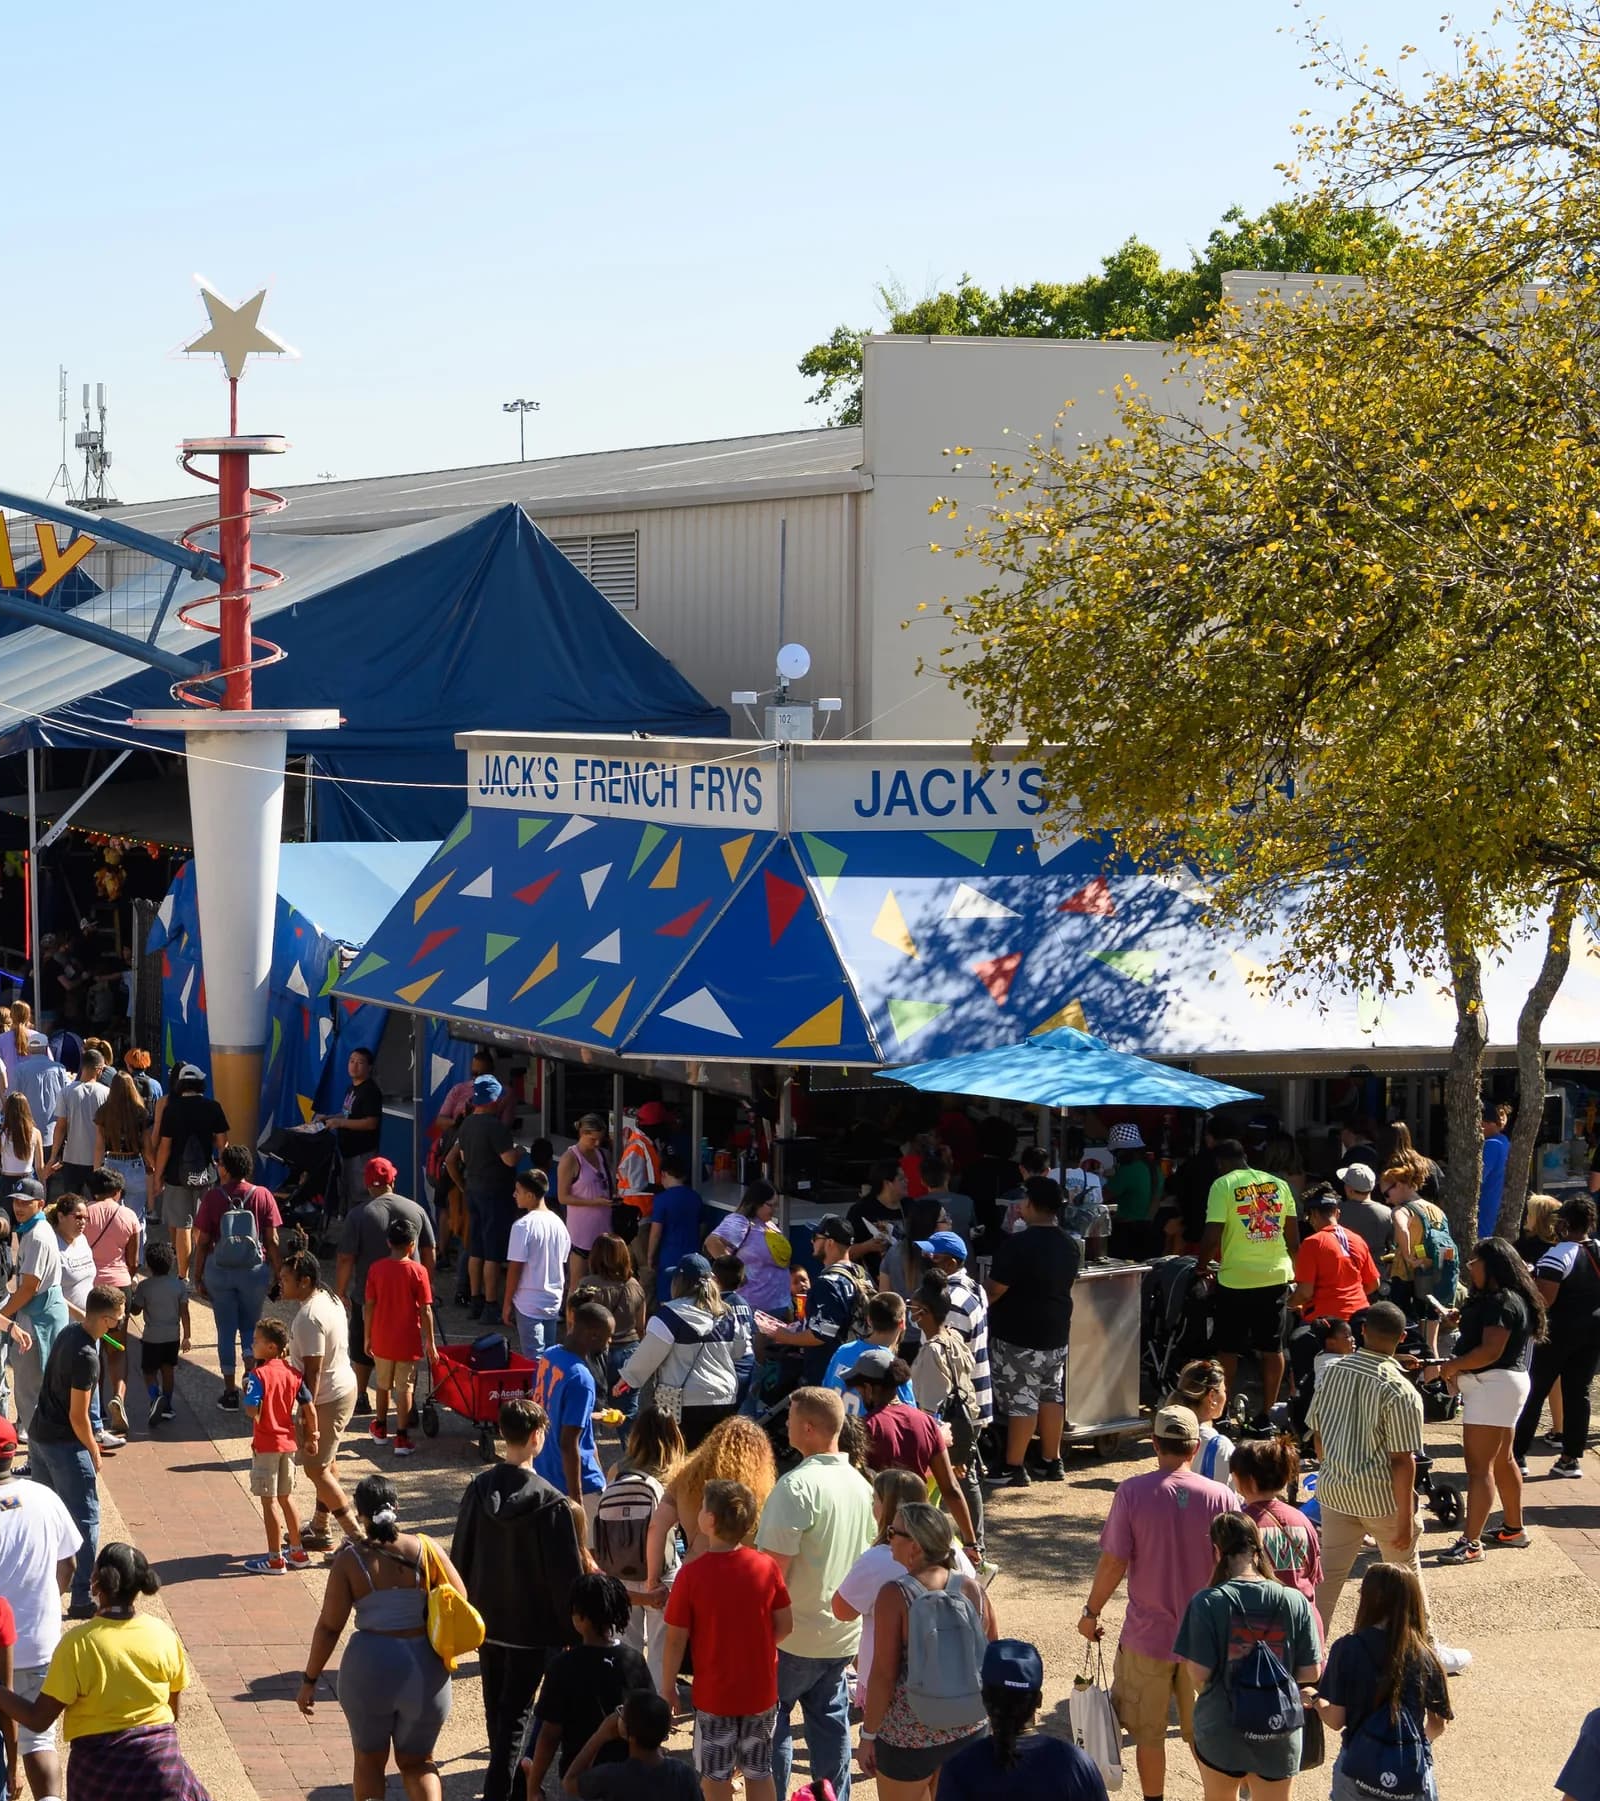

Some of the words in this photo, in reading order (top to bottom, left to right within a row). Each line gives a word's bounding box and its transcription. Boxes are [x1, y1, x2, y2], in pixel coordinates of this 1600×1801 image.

[778, 713, 792, 725] 102
[478, 754, 560, 801] JACK'S
[574, 757, 678, 808] FRENCH
[690, 765, 763, 816] FRYS
[853, 767, 1051, 819] JACK'S
